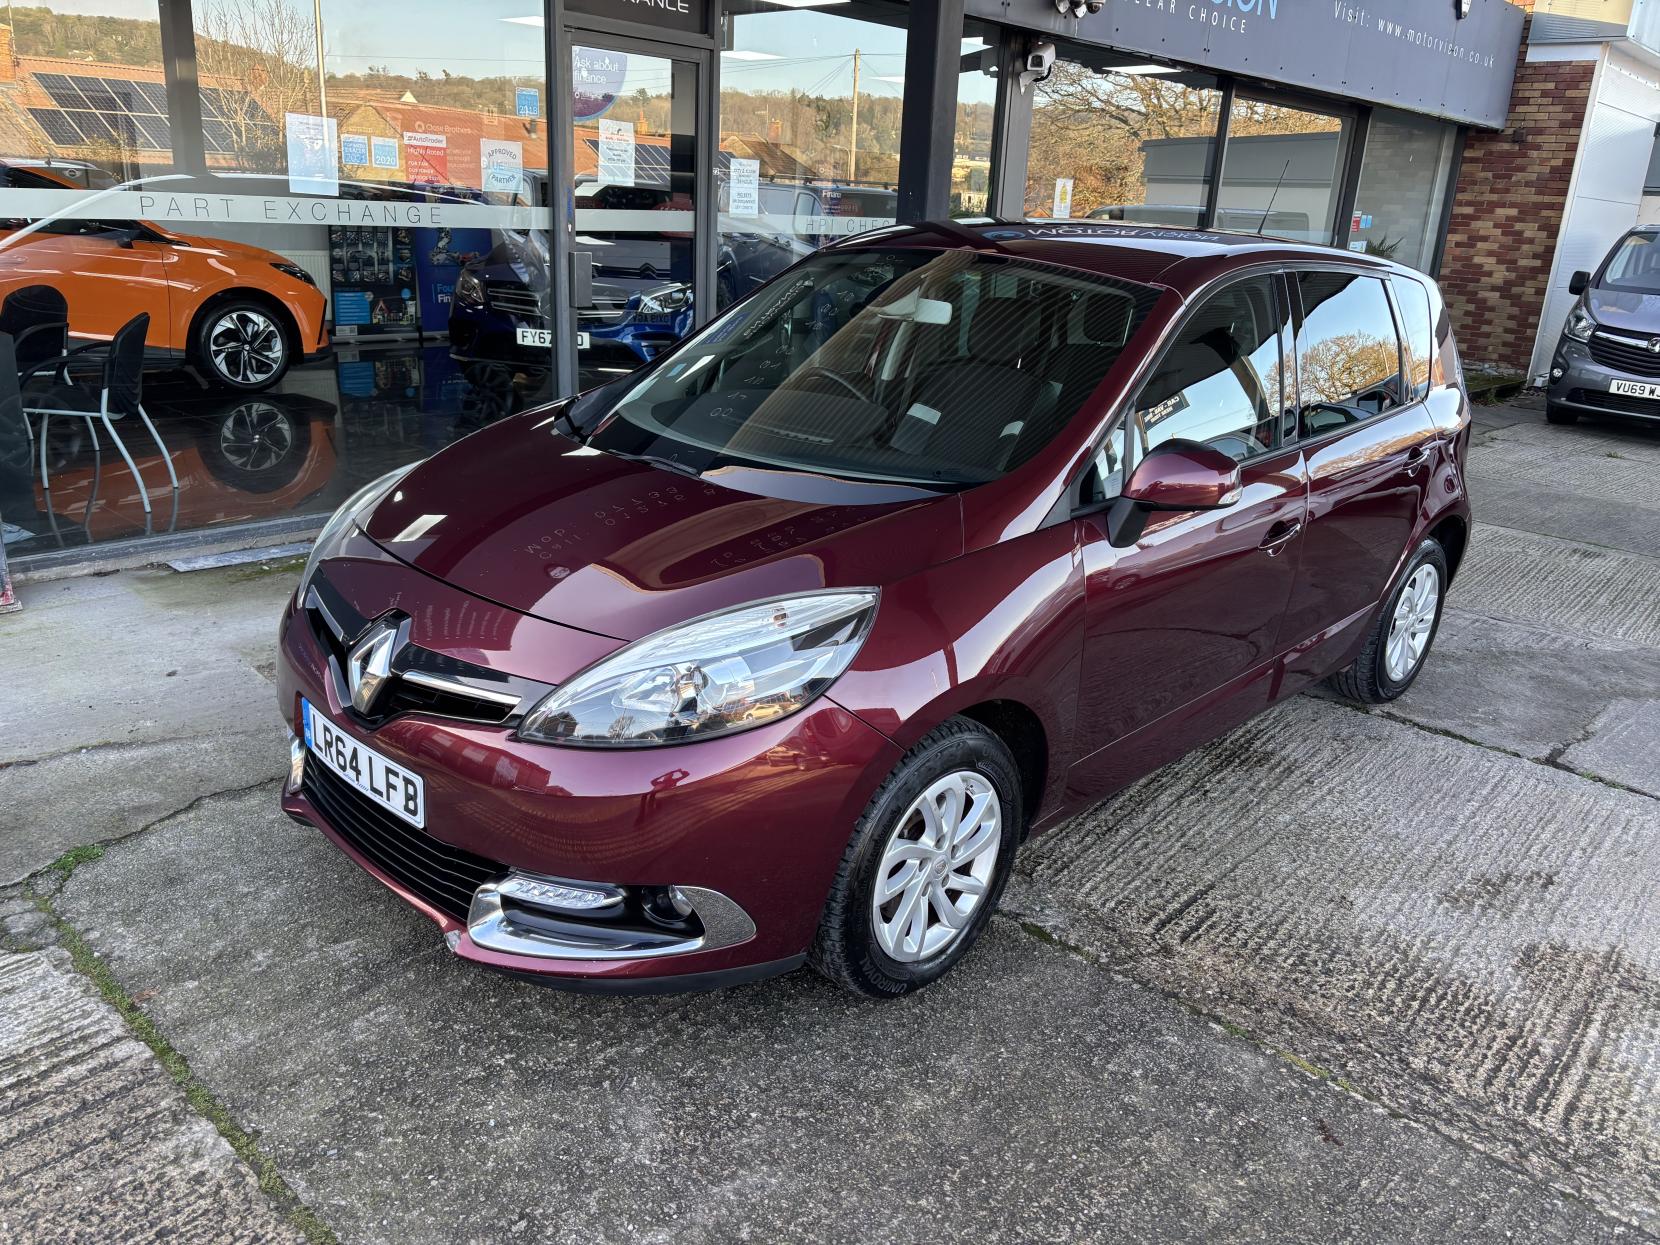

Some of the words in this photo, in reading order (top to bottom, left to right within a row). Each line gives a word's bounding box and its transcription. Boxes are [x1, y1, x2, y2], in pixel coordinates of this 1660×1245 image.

[1189, 5, 1247, 34] CHOICE
[1333, 0, 1370, 28] Visit:
[593, 58, 620, 73] about
[375, 155, 396, 165] 2020
[487, 148, 517, 160] APPROVED
[139, 195, 234, 219] PART
[263, 200, 442, 224] EXCHANGE
[436, 283, 453, 293] Fou
[437, 294, 451, 303] Fin
[1616, 381, 1646, 395] VU69
[312, 713, 362, 782] LR64
[368, 754, 419, 817] LFB
[859, 951, 908, 994] UNIROYAL
